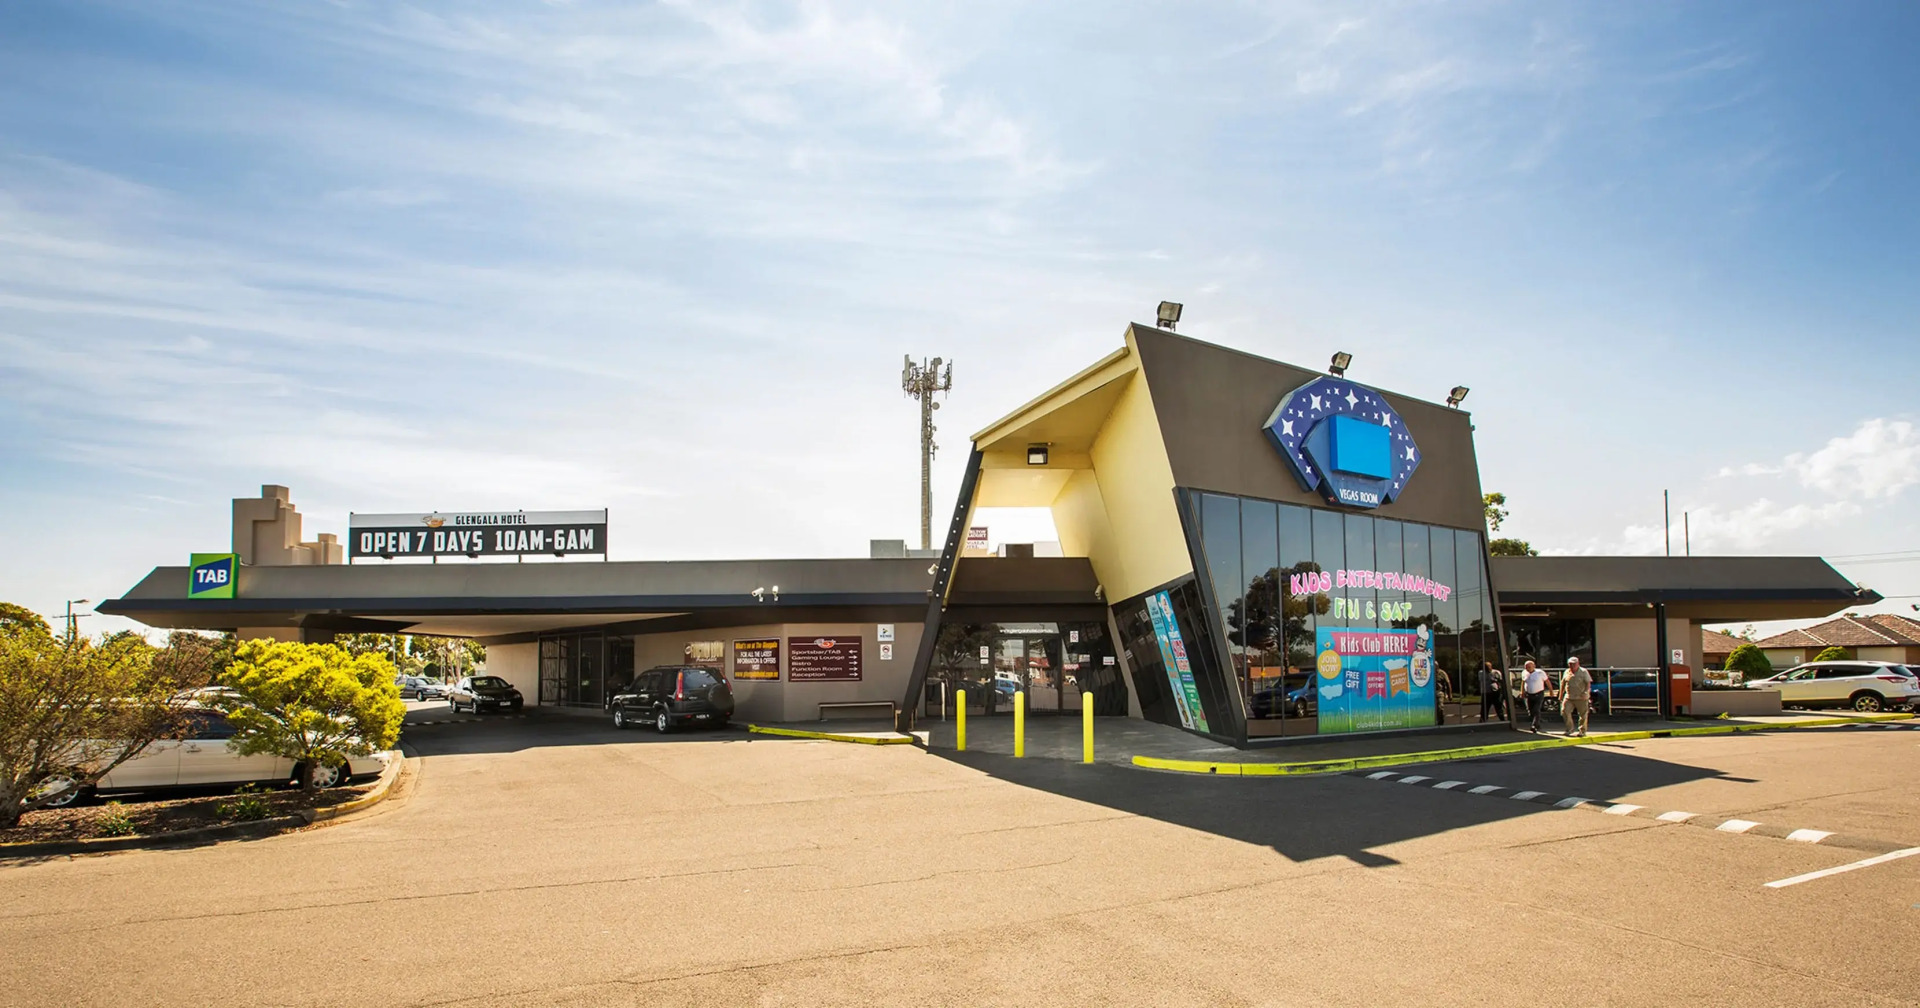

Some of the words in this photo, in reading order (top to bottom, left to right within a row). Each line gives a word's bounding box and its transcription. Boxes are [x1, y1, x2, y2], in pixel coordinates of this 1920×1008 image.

[1339, 488, 1359, 501] VEGAS
[1360, 491, 1379, 504] ROOM
[455, 515, 498, 525] GLENGALA
[501, 514, 527, 524] HOTEL
[360, 531, 411, 553] OPEN
[416, 531, 428, 552] 7
[433, 530, 483, 552] DAYS
[495, 529, 594, 551] 10AM-6AM
[196, 569, 228, 583] TAB
[1290, 571, 1332, 596] KIDS
[1336, 569, 1451, 602] ENTERTAINMENT
[1334, 597, 1360, 620] FRI
[1365, 600, 1377, 619] &
[1380, 601, 1413, 622] SAT
[1340, 636, 1360, 653] Kids
[1362, 636, 1380, 653] Club
[1383, 635, 1409, 653] HERE!
[1321, 655, 1338, 663] JOIN
[1320, 664, 1338, 672] NOW!
[1345, 670, 1360, 680] FREE
[1345, 679, 1360, 689] GIFT
[1356, 720, 1402, 729] club4kids.com.au
